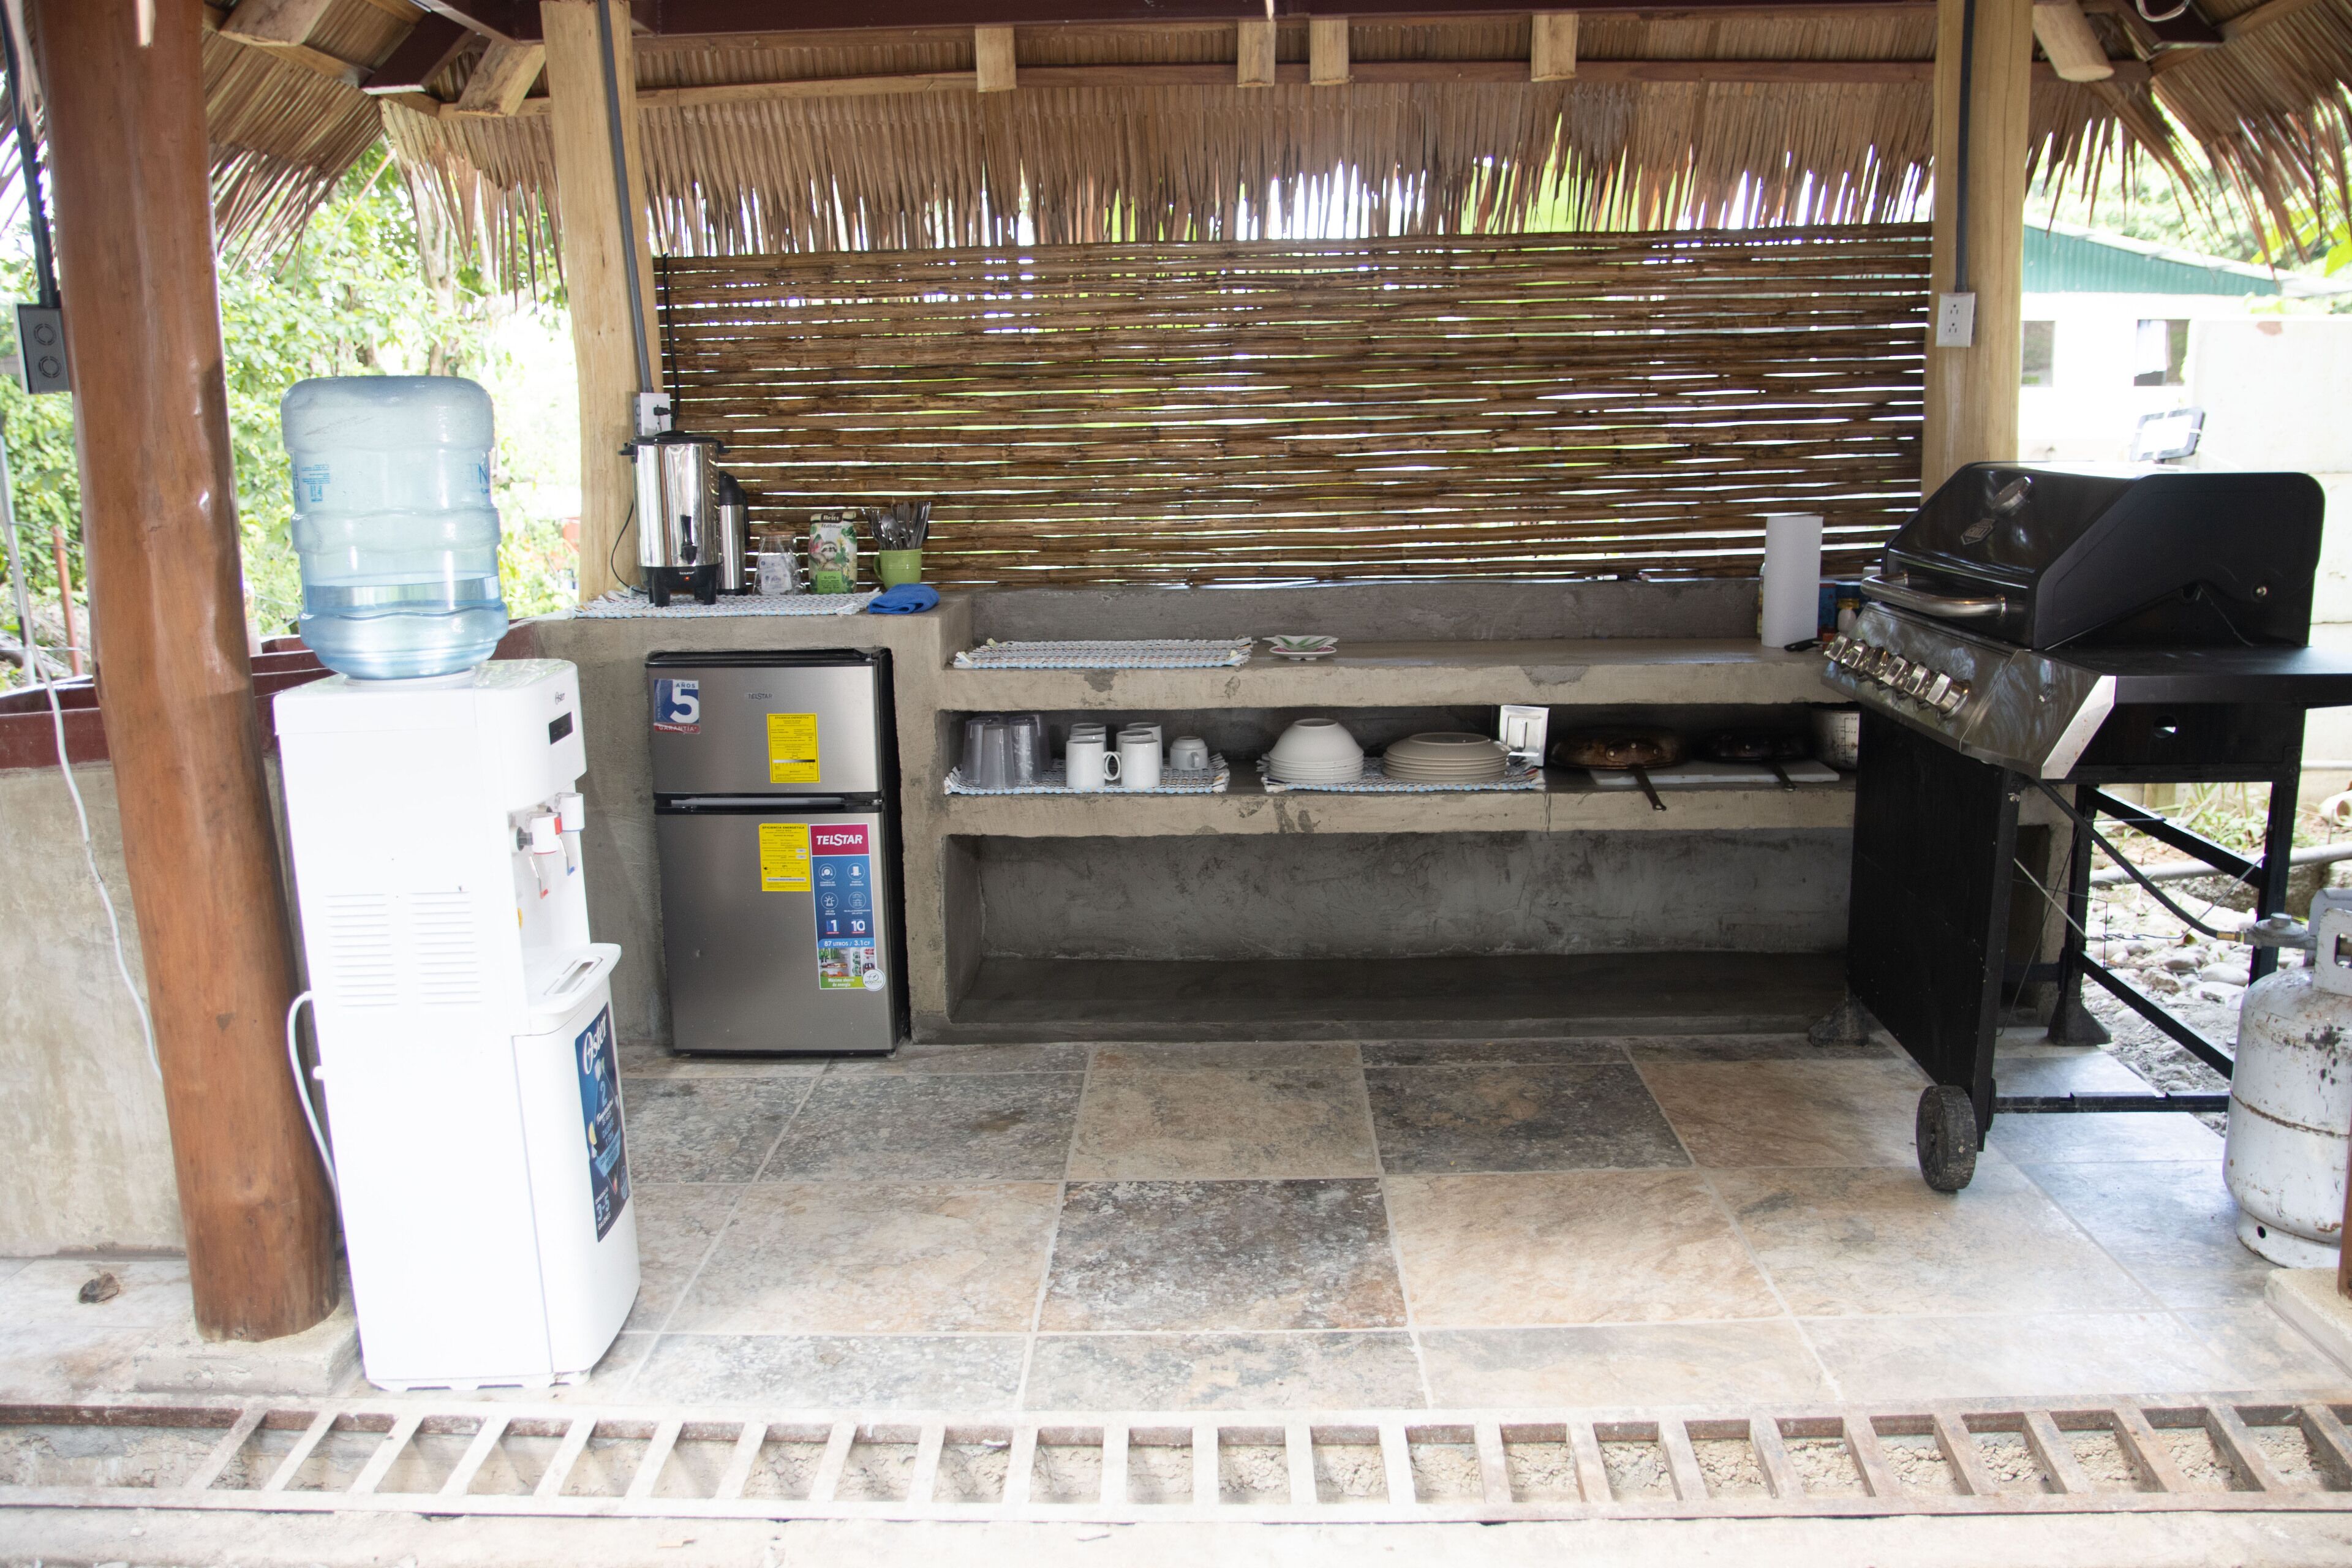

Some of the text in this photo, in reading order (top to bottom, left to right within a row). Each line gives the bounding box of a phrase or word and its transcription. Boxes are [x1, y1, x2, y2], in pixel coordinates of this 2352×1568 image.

[669, 680, 699, 724] 5
[816, 834, 863, 846] TELSTAR
[831, 919, 837, 932] 1
[851, 920, 865, 932] 10
[584, 1012, 606, 1075] Oster
[600, 1080, 607, 1107] 2
